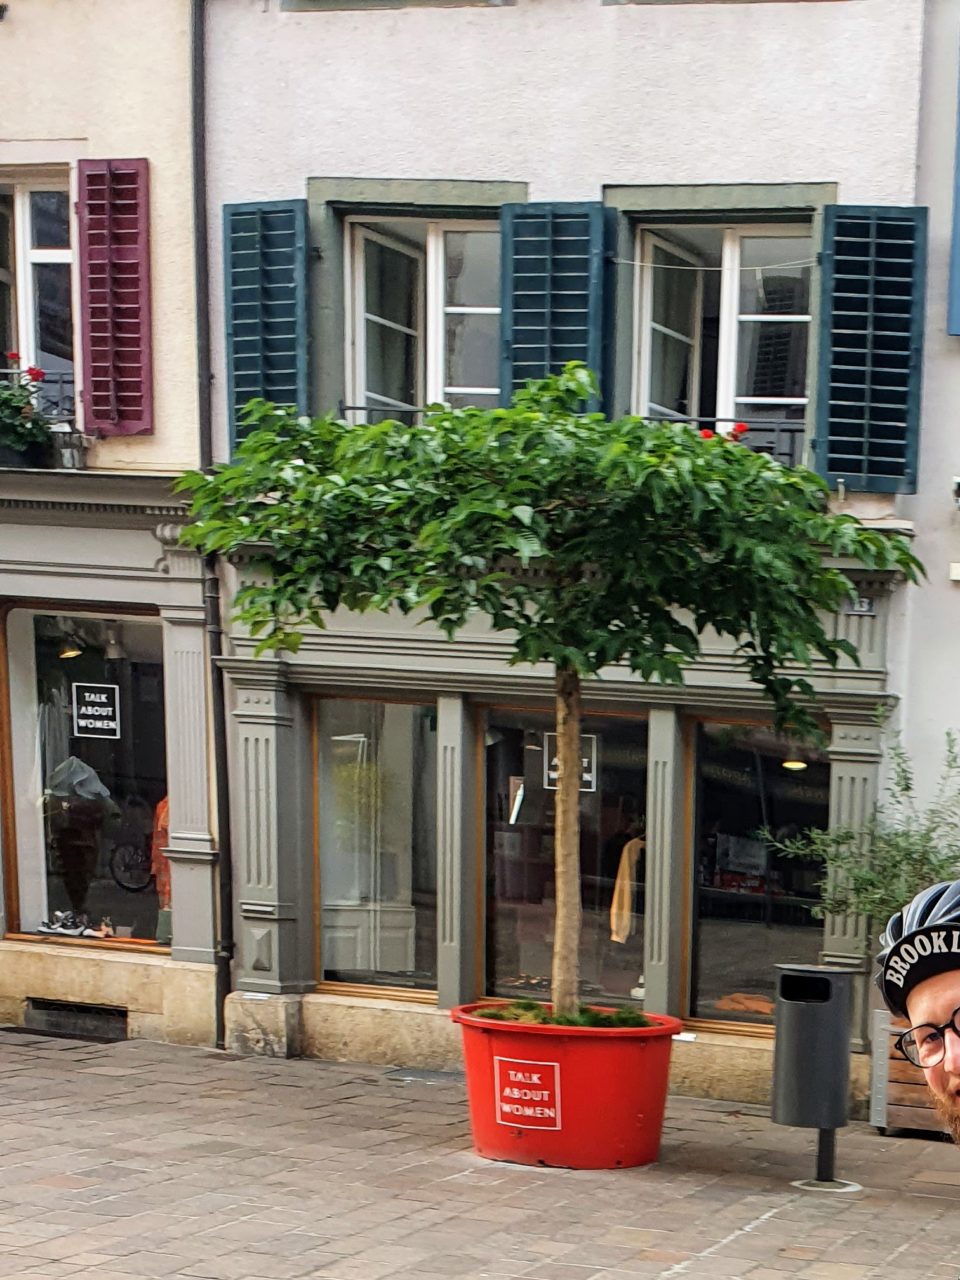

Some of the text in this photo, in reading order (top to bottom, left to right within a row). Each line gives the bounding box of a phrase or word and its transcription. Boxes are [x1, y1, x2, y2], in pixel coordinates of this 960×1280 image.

[84, 692, 108, 702] TALK
[80, 706, 113, 716] ABOUT
[77, 719, 117, 729] WOMEN
[508, 1070, 543, 1084] TALK
[503, 1086, 551, 1101] ABOUT
[500, 1102, 556, 1118] WOMEN
